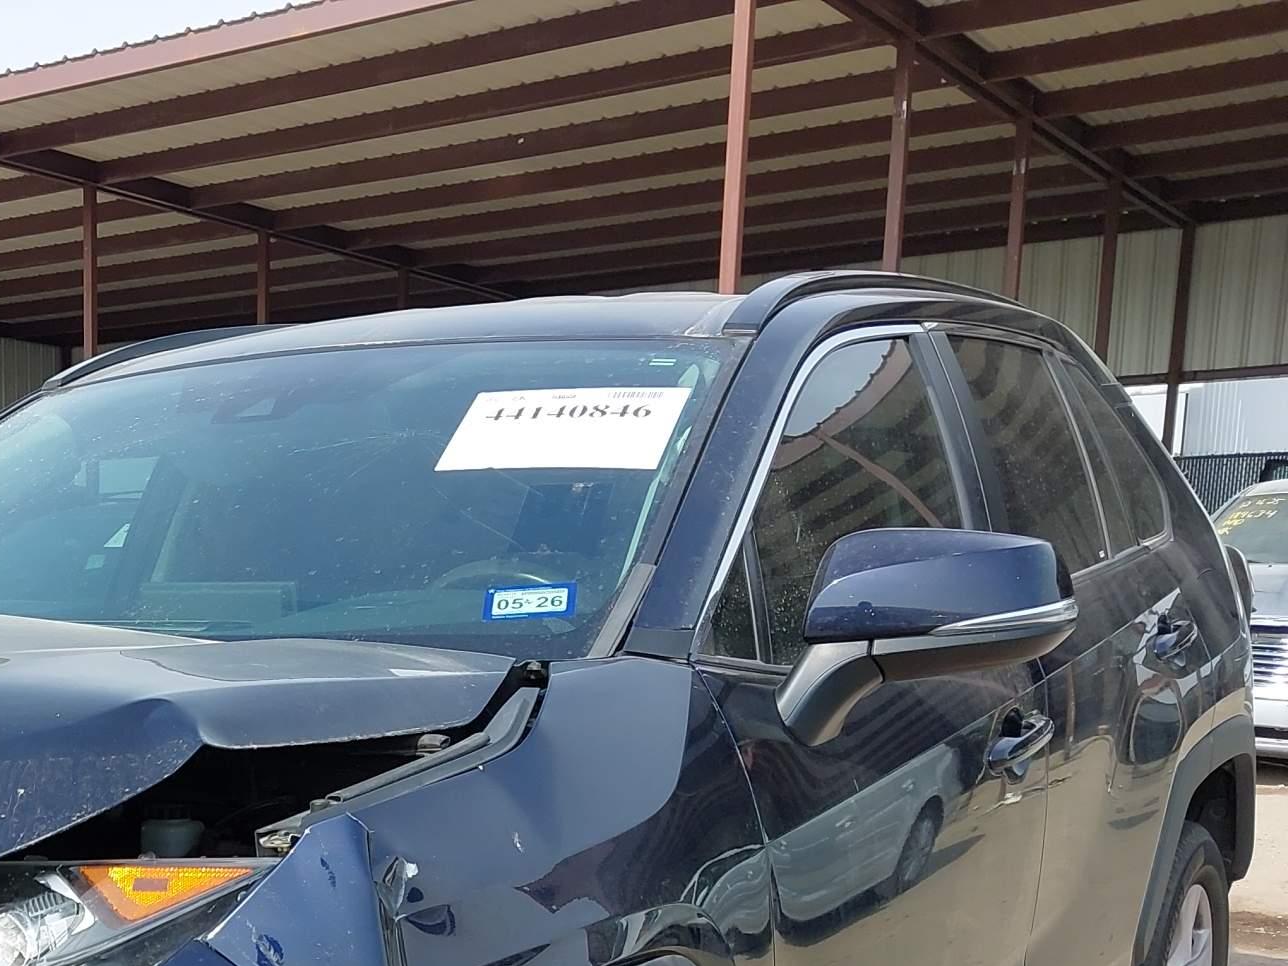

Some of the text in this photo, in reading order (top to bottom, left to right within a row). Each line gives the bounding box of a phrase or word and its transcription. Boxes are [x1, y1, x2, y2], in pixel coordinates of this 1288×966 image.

[485, 403, 653, 421] 44140846
[497, 595, 563, 611] 05 26
